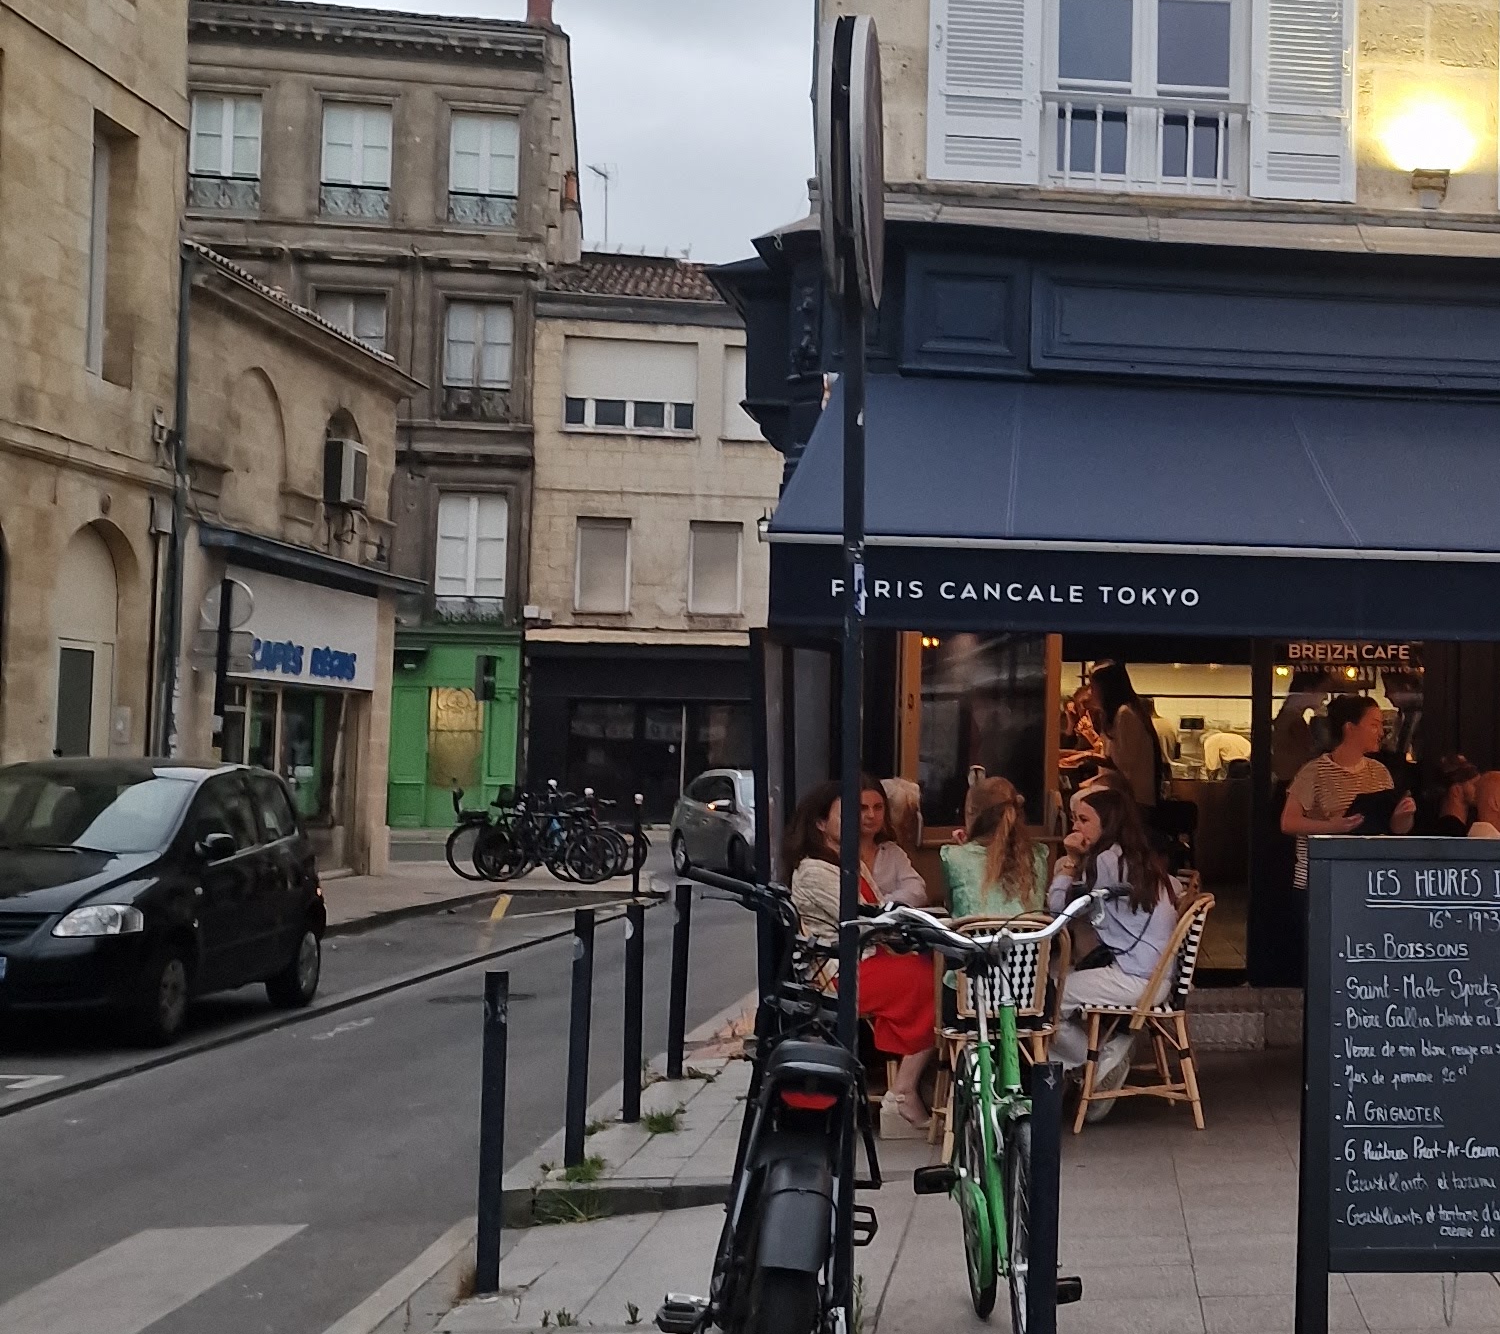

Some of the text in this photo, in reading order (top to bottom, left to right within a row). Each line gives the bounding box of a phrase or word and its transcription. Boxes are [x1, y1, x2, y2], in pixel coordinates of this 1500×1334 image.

[831, 579, 1200, 608] PRIS CANCALE TOKYO
[1288, 643, 1411, 660] BREIZH CAFE
[1368, 869, 1400, 897] LES
[1415, 869, 1482, 898] HEURES
[1346, 935, 1376, 958] LES
[1346, 1005, 1383, 1029] Bière
[1435, 1006, 1473, 1028] blonde
[1381, 1040, 1396, 1058] de
[1372, 1068, 1385, 1085] de
[1390, 1071, 1434, 1091] pomme
[1345, 1094, 1357, 1121] À
[1344, 1138, 1356, 1163] 6
[1437, 1172, 1450, 1190] et
[1480, 1223, 1495, 1238] de
